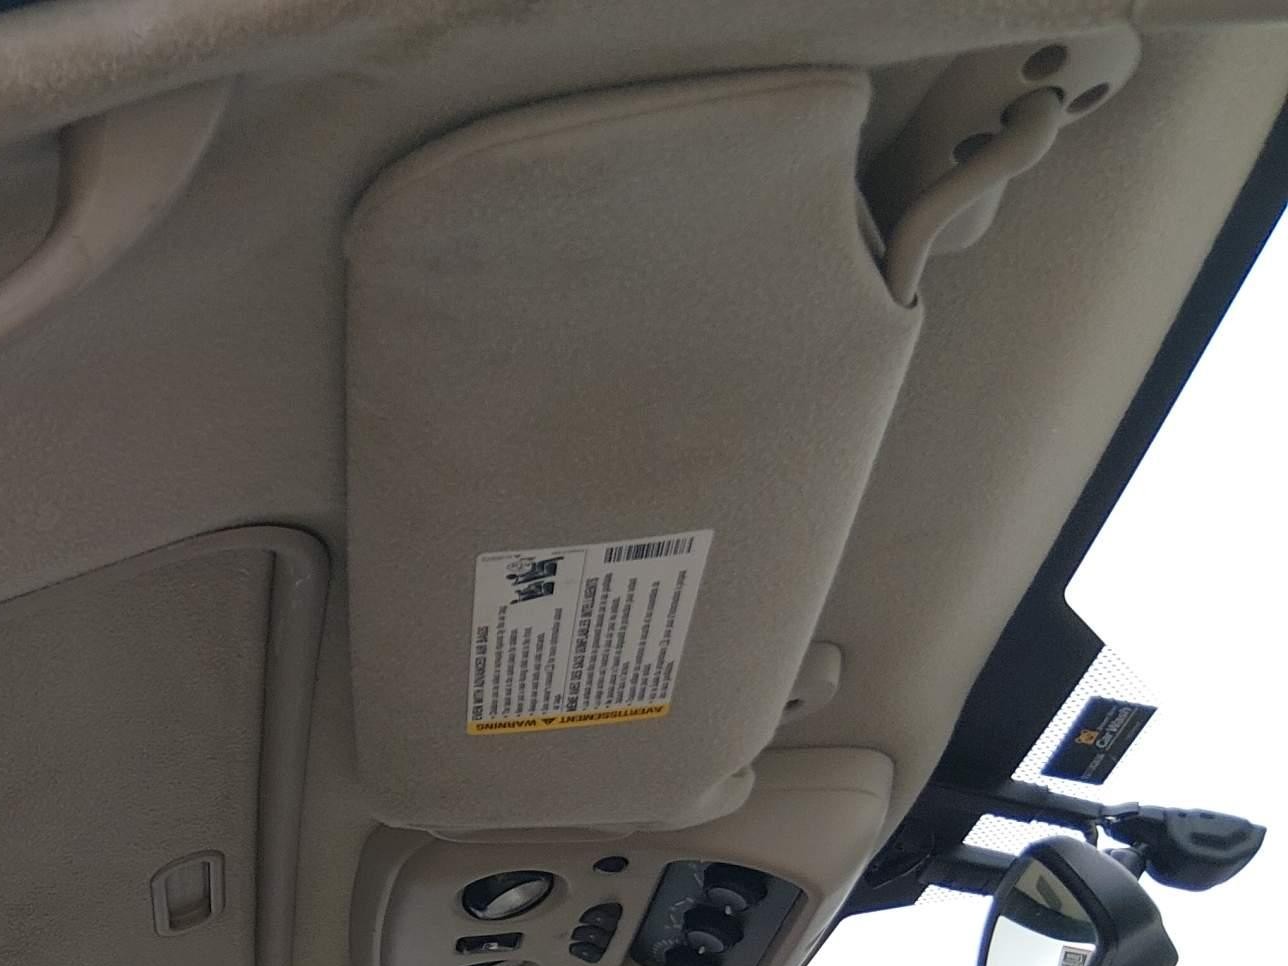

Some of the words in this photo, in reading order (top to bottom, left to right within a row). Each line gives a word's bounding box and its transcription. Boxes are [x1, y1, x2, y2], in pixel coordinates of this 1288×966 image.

[558, 705, 664, 724] AVERTISSEMENT
[1105, 707, 1132, 732] Wash
[475, 718, 537, 732] WARNING
